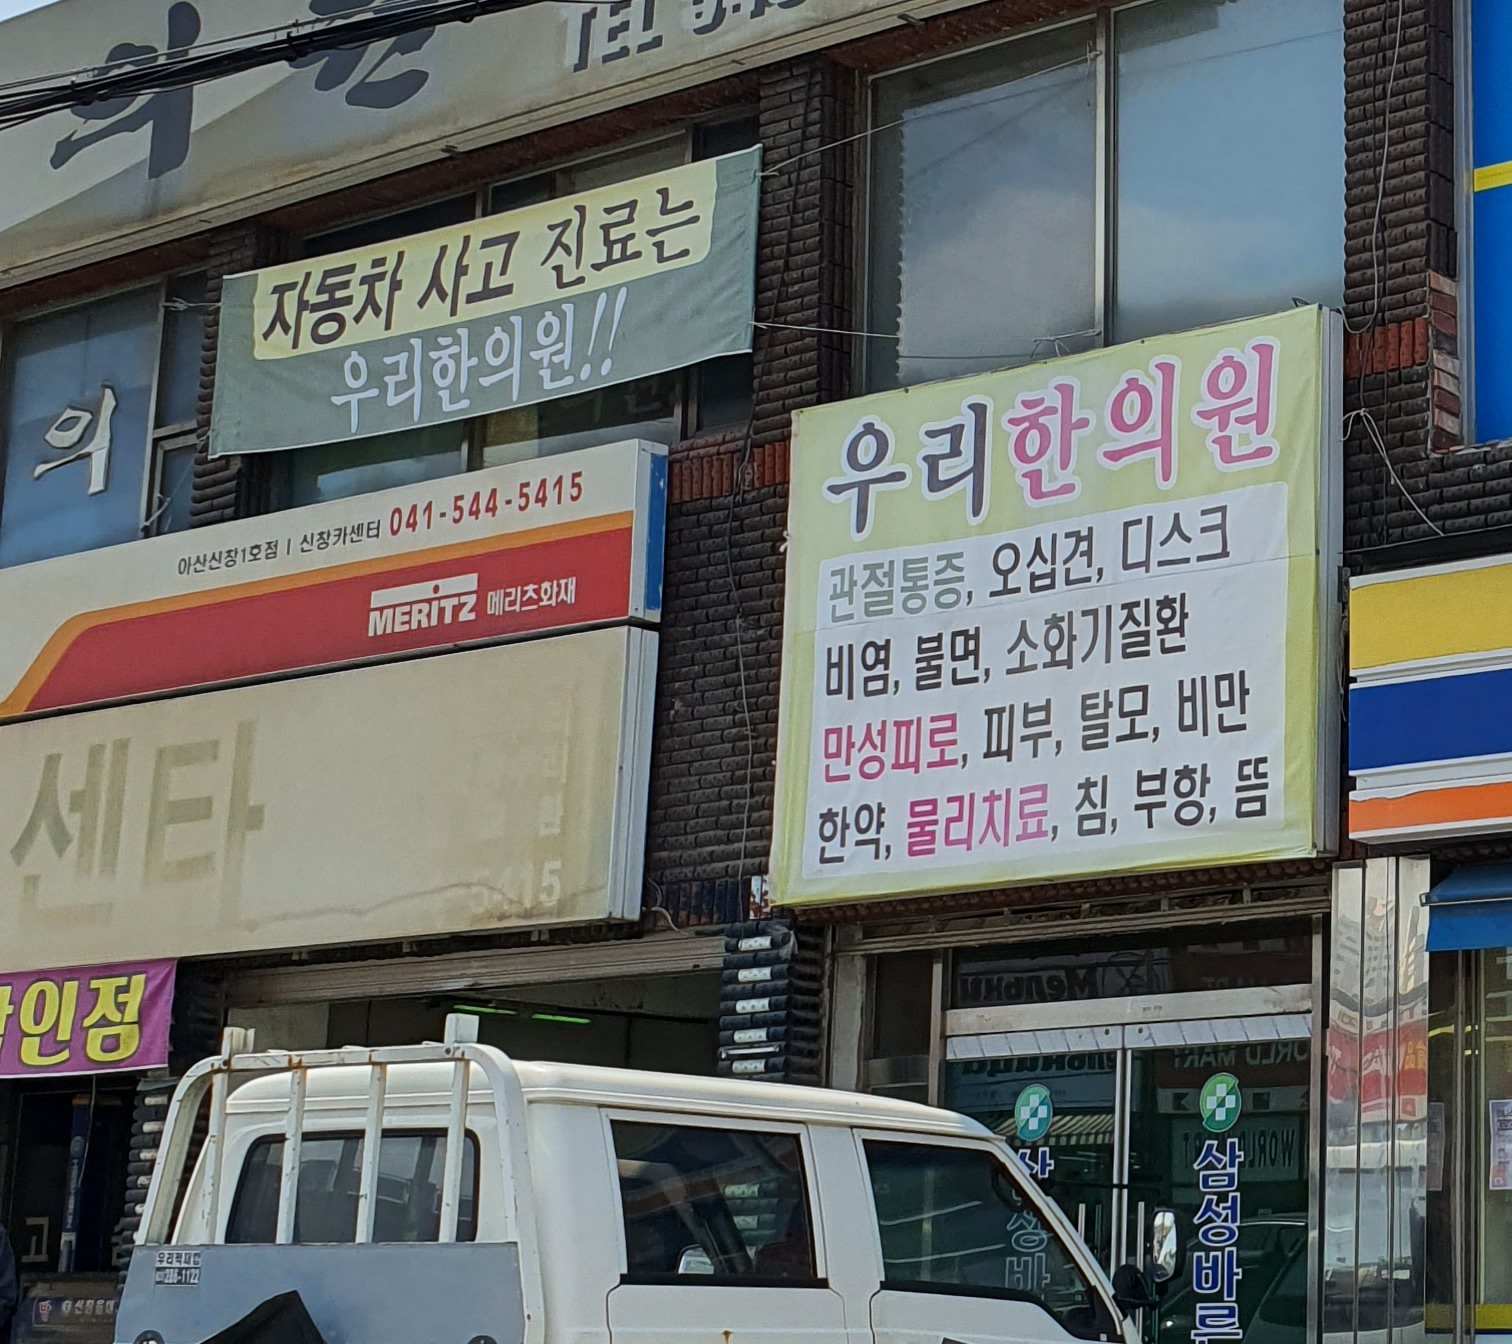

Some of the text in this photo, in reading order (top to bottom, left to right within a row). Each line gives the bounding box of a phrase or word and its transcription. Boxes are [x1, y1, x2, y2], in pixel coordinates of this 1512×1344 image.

[260, 188, 702, 350] 자동차 사고 진료는
[330, 286, 627, 433] 우리한의원!!
[34, 382, 117, 496] 의
[825, 339, 1279, 537] 우리한의원
[177, 470, 584, 577] 아산신창1호점 신창카센터 041-544-5415
[828, 505, 1231, 623] 관절통증, 오십견, 디스크
[367, 576, 577, 638] MERITZ 메리츠화재
[825, 593, 1190, 701] 비염, 불면, 소화기질환
[823, 670, 1250, 784] 만성피로, 피부, 탈모, 비만
[817, 755, 1270, 864] 한약, 물리치료, 침, 부항, 뜸
[0, 973, 147, 1066] 인점
